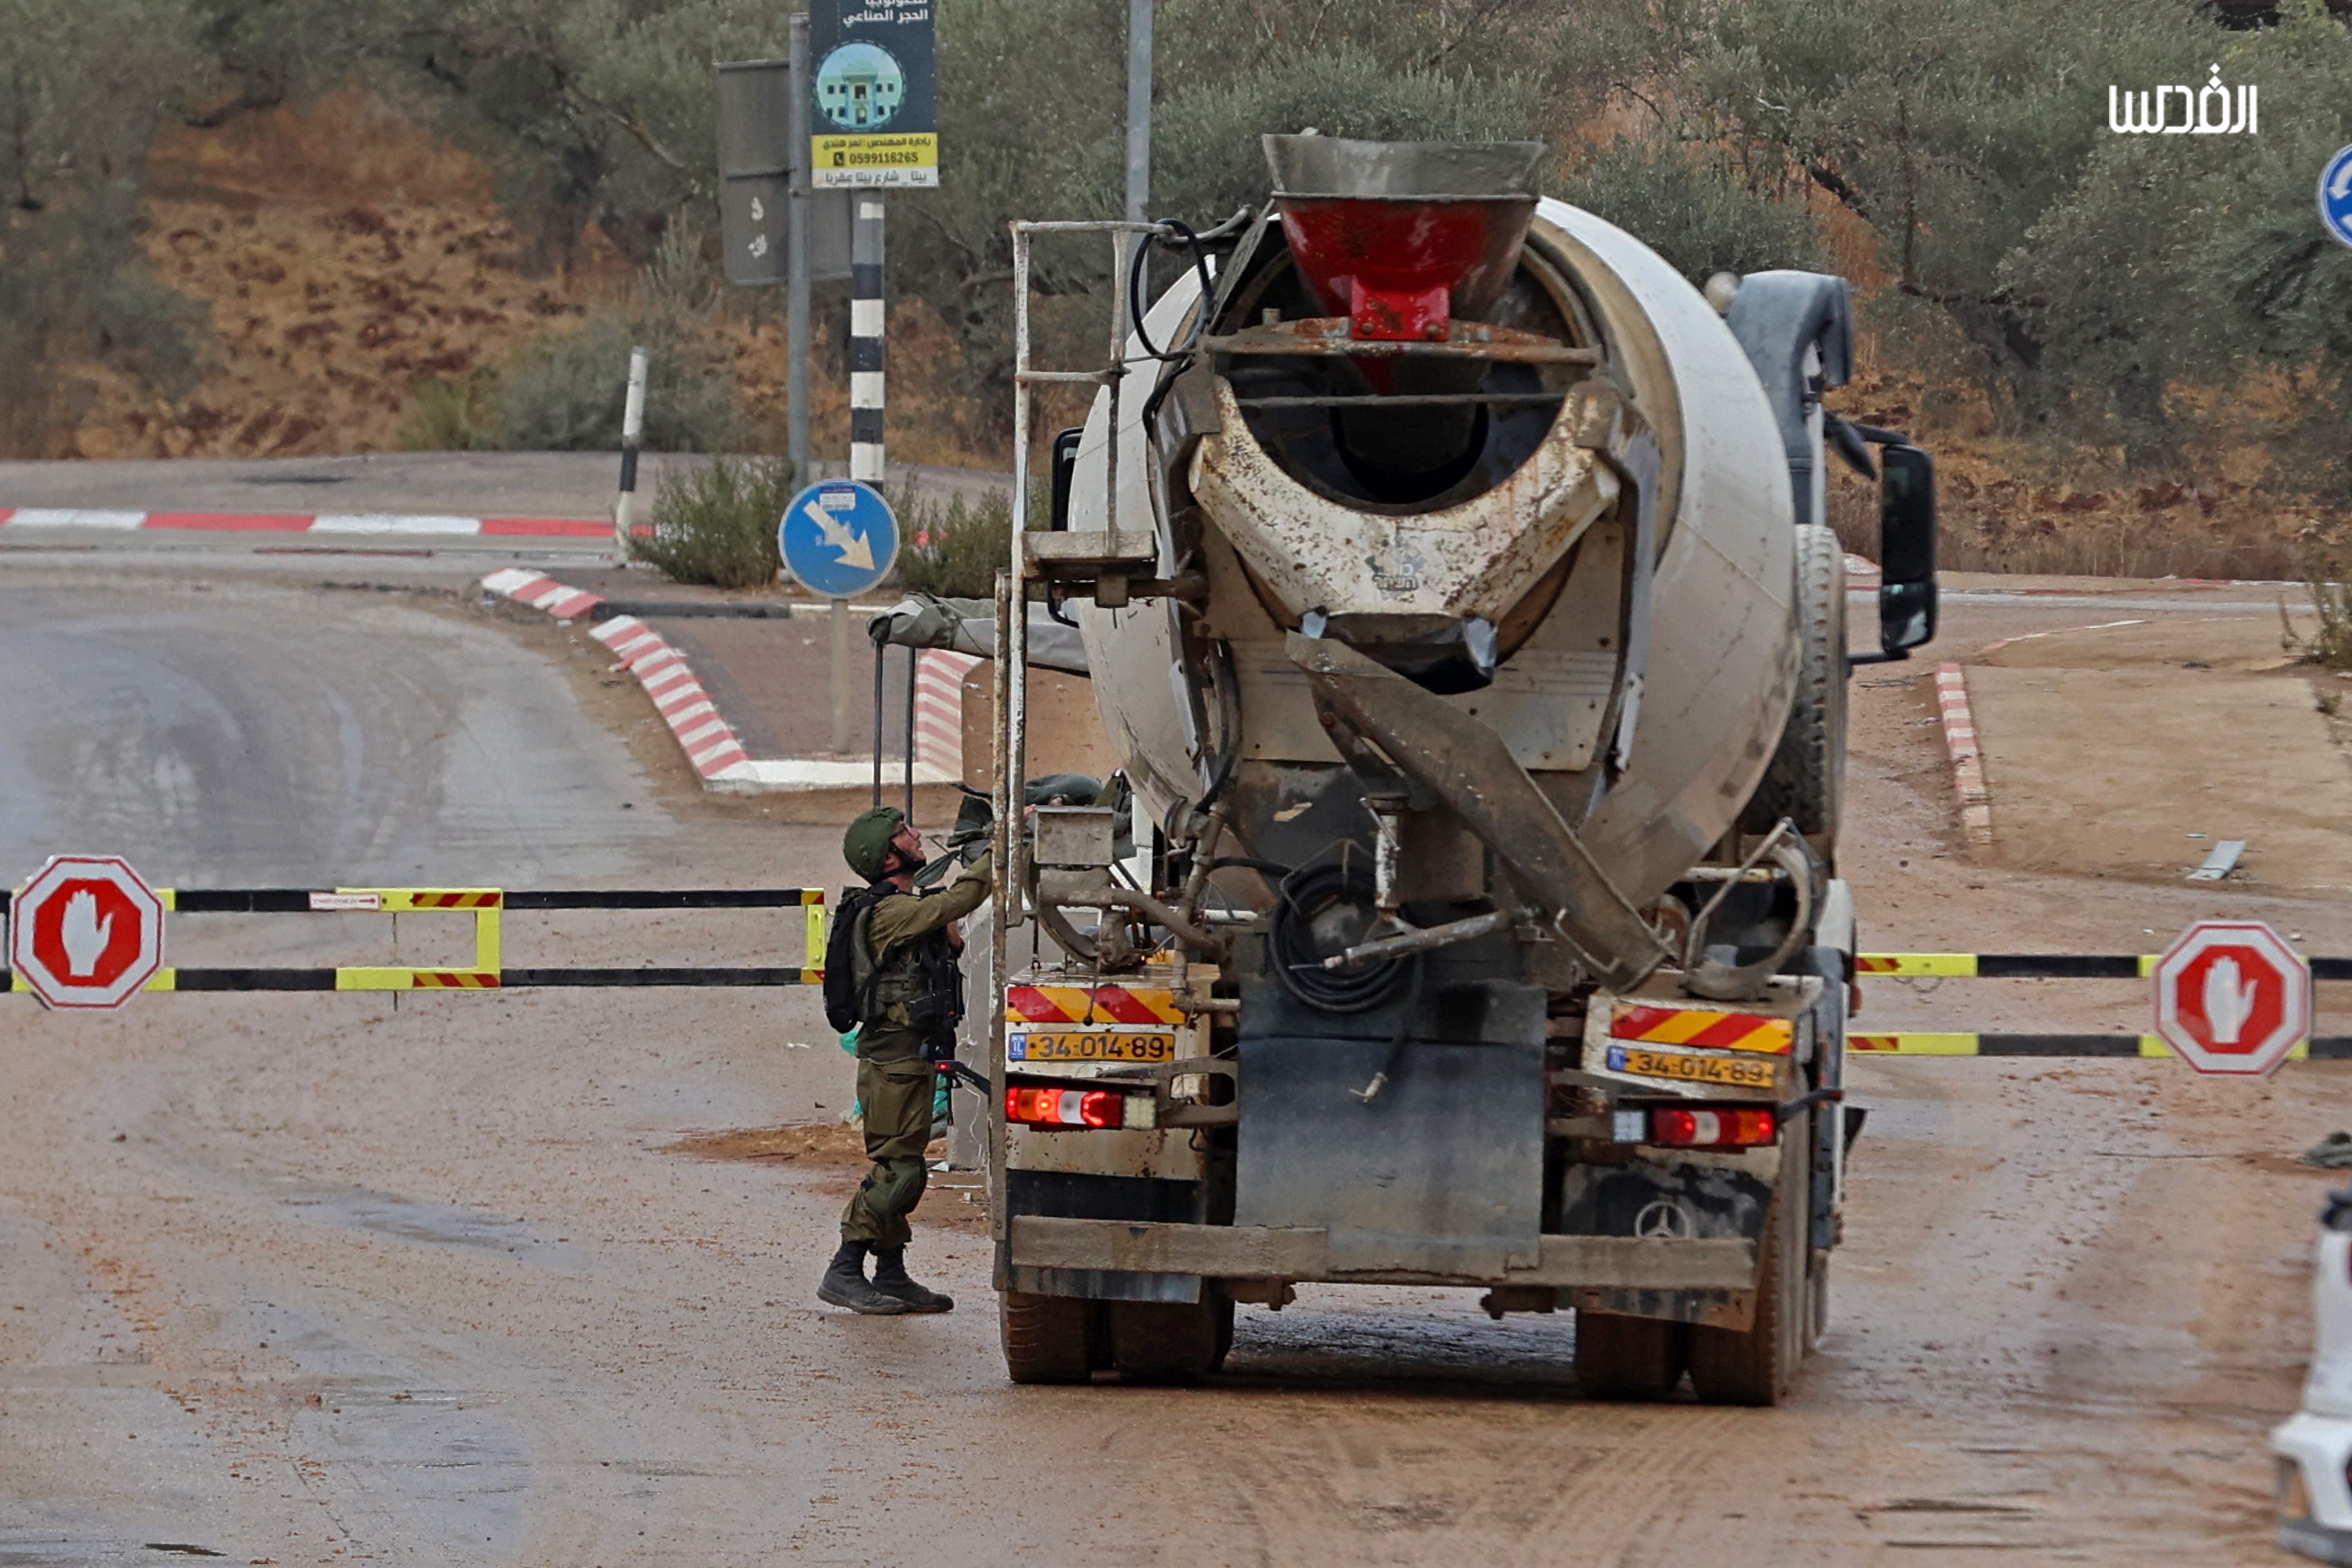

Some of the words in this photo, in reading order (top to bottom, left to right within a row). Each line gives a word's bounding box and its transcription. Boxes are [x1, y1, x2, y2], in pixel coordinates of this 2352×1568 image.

[843, 9, 893, 28] الصناعي
[897, 9, 928, 24] الحجر
[825, 172, 853, 185] عقربا
[855, 172, 871, 183] بيتا
[874, 170, 899, 184] شارع
[911, 171, 927, 182] بيتا
